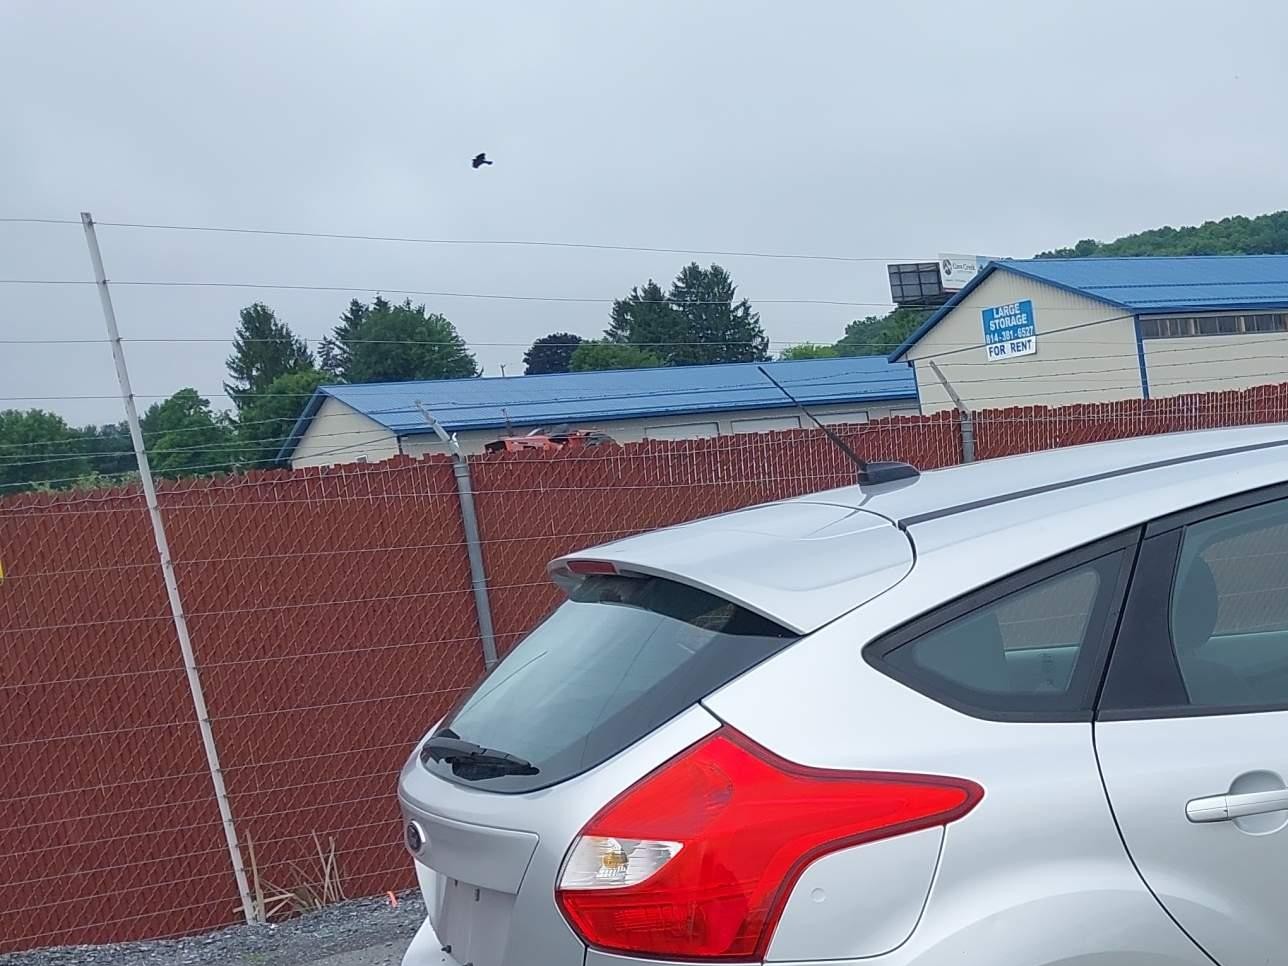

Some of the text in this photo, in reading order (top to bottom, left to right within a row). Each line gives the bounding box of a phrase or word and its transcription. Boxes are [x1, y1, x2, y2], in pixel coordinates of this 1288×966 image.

[993, 303, 1020, 318] LARGE
[989, 313, 1028, 331] STORAGE
[988, 339, 1032, 357] FOR RENT
